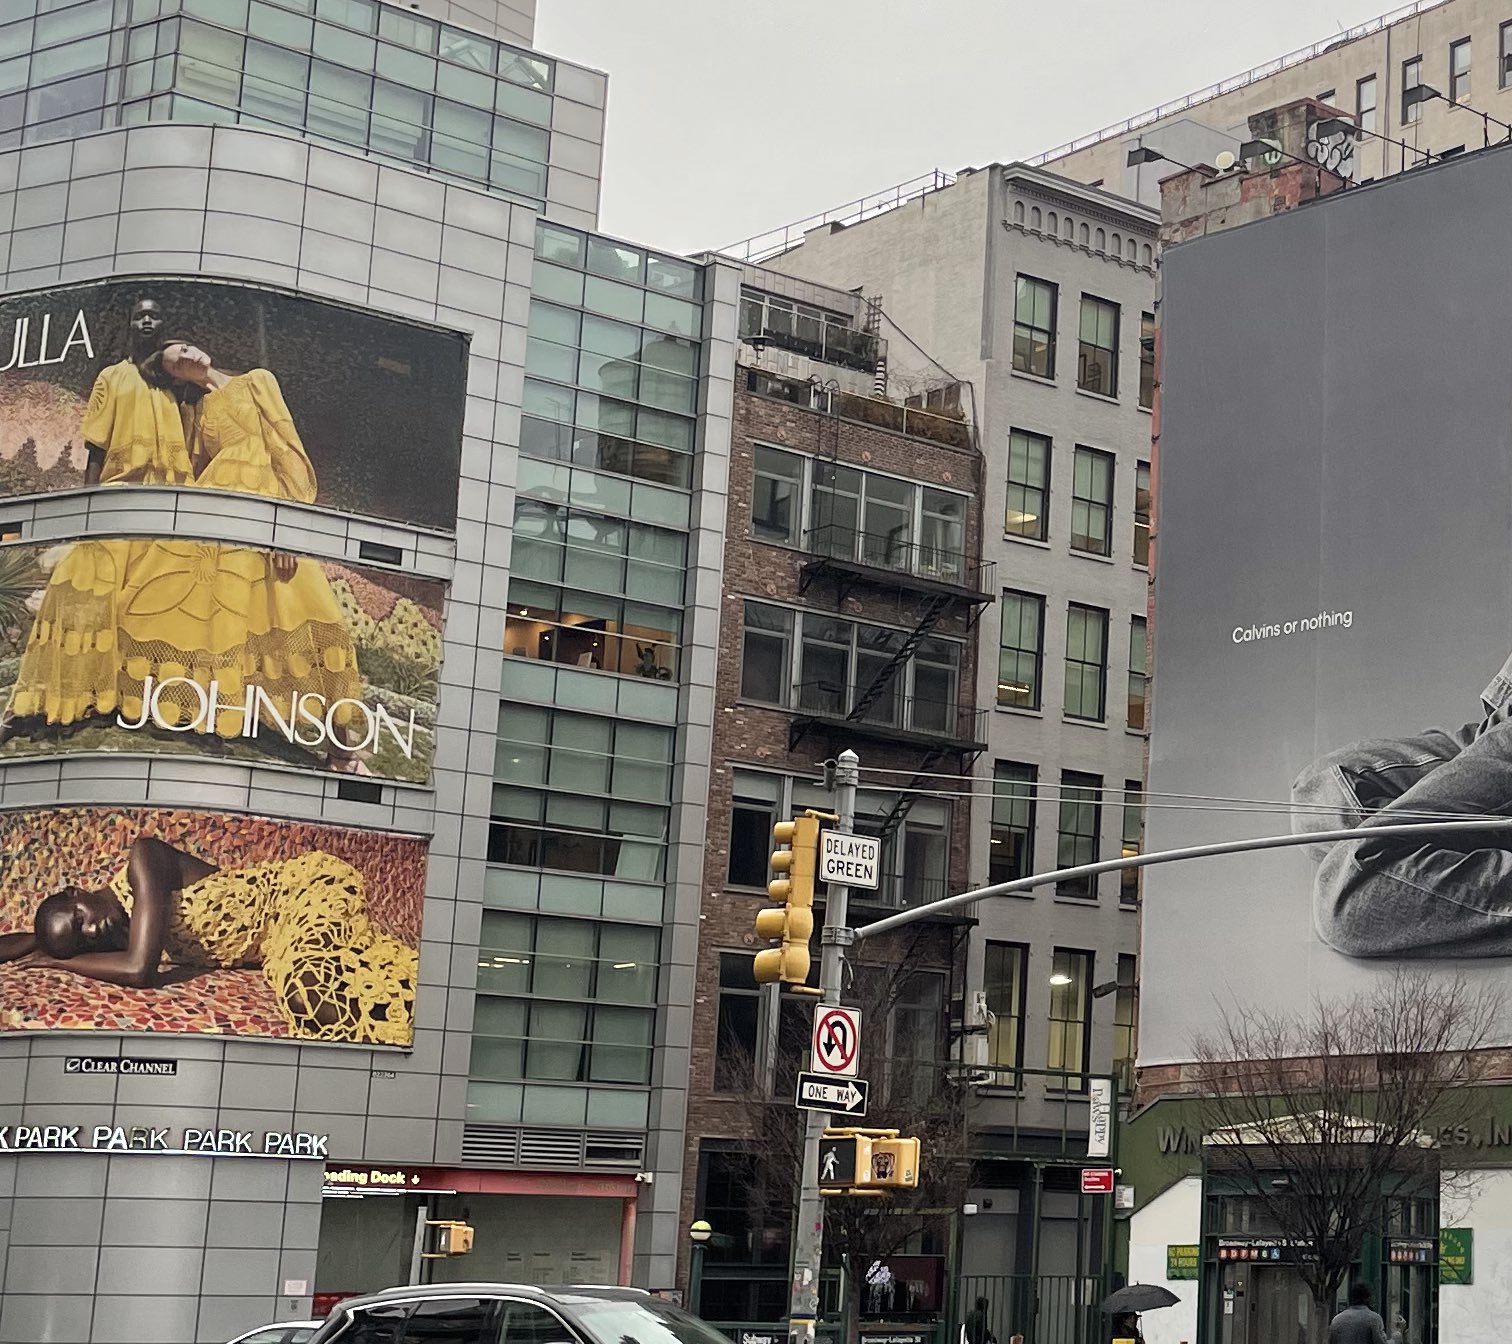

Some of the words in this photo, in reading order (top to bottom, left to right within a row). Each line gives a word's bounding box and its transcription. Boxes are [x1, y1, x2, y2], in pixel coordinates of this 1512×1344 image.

[1232, 624, 1280, 643] Calvins
[1283, 621, 1298, 634] or
[1300, 610, 1353, 628] nothing
[116, 676, 414, 759] JOHNSON
[826, 838, 875, 860] DELAYED
[826, 859, 873, 880] GREEN
[82, 1058, 117, 1072] CLEAR
[120, 1059, 175, 1074] CHANNEL
[807, 1085, 828, 1101] ONE
[836, 1087, 857, 1103] WAY
[15, 1126, 80, 1149] PARK
[93, 1127, 170, 1150] PARK
[184, 1129, 252, 1154] PARK
[265, 1132, 329, 1156] PARK
[324, 1169, 368, 1184] oading
[371, 1170, 405, 1185] Dock
